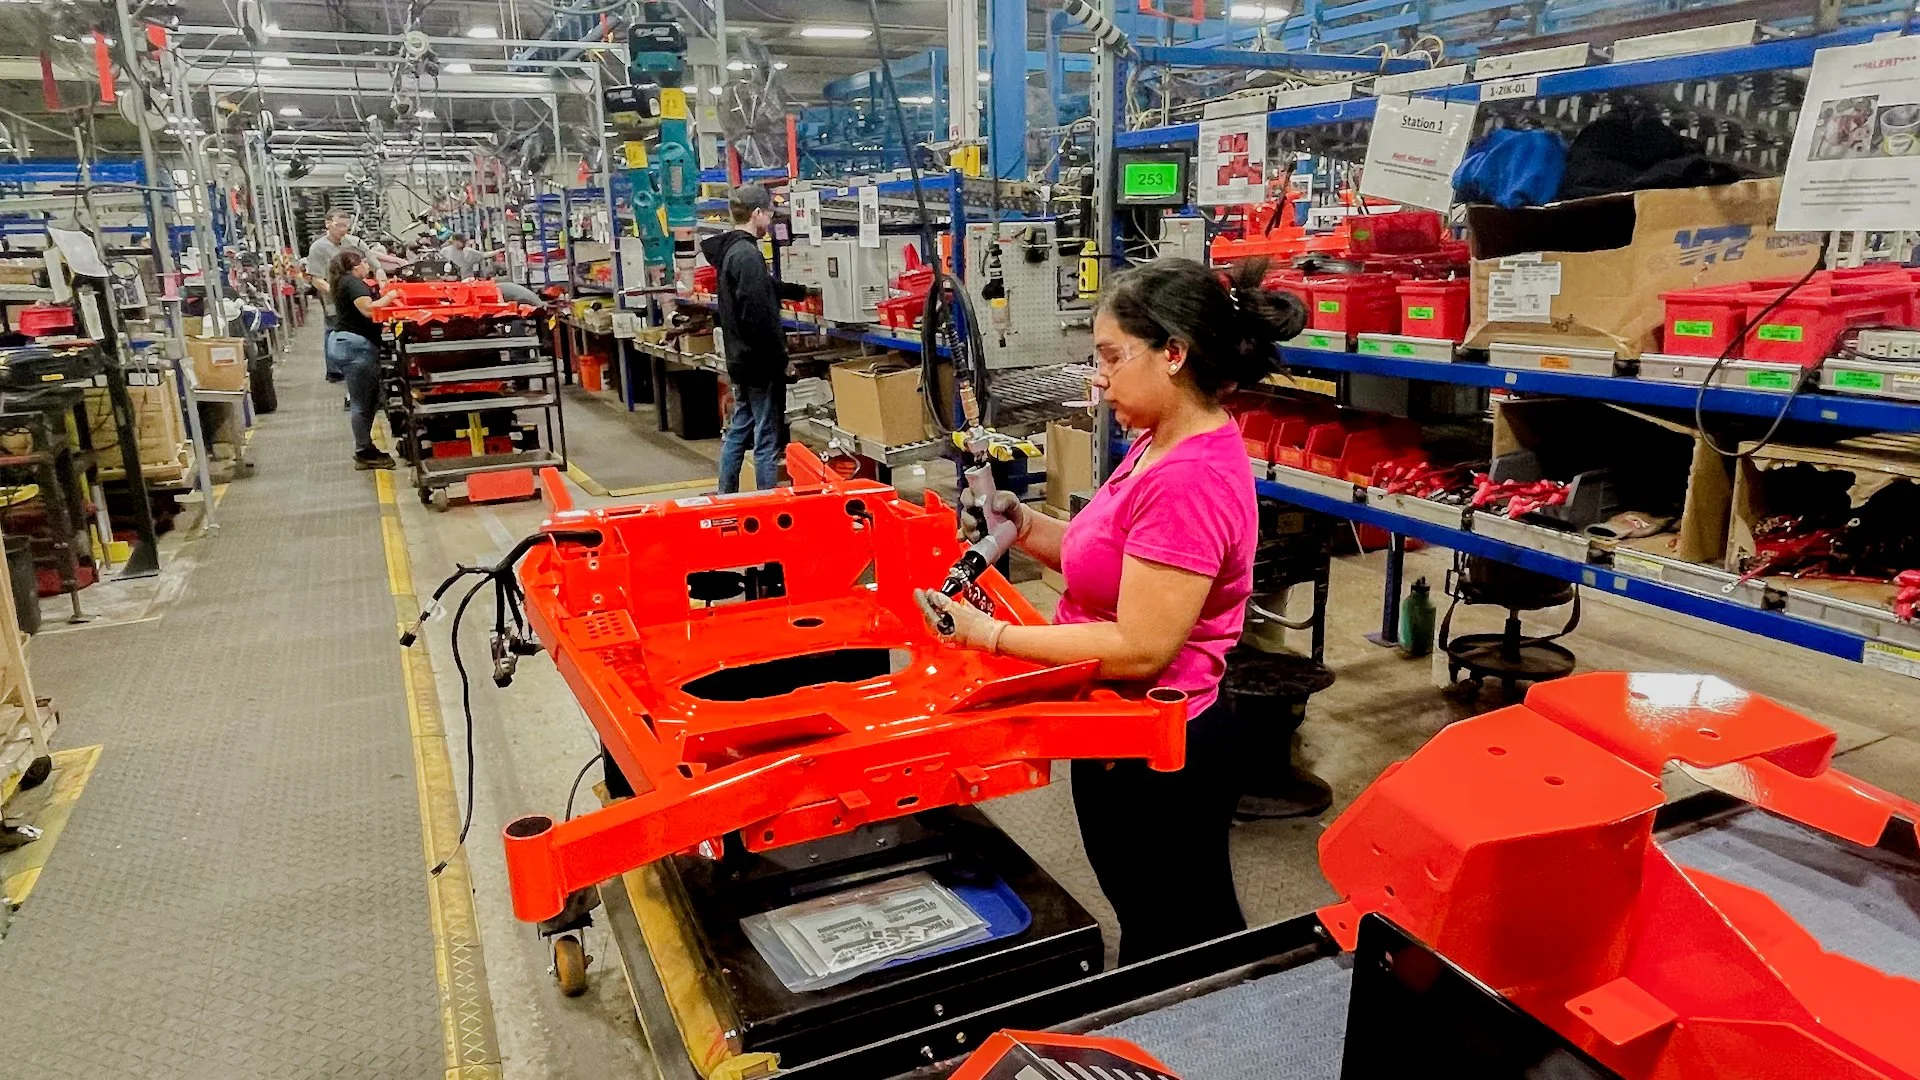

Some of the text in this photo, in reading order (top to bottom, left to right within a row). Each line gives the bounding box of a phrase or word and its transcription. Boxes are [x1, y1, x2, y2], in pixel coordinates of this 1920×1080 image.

[1401, 115, 1443, 131] Station 1
[1138, 173, 1164, 186] 253
